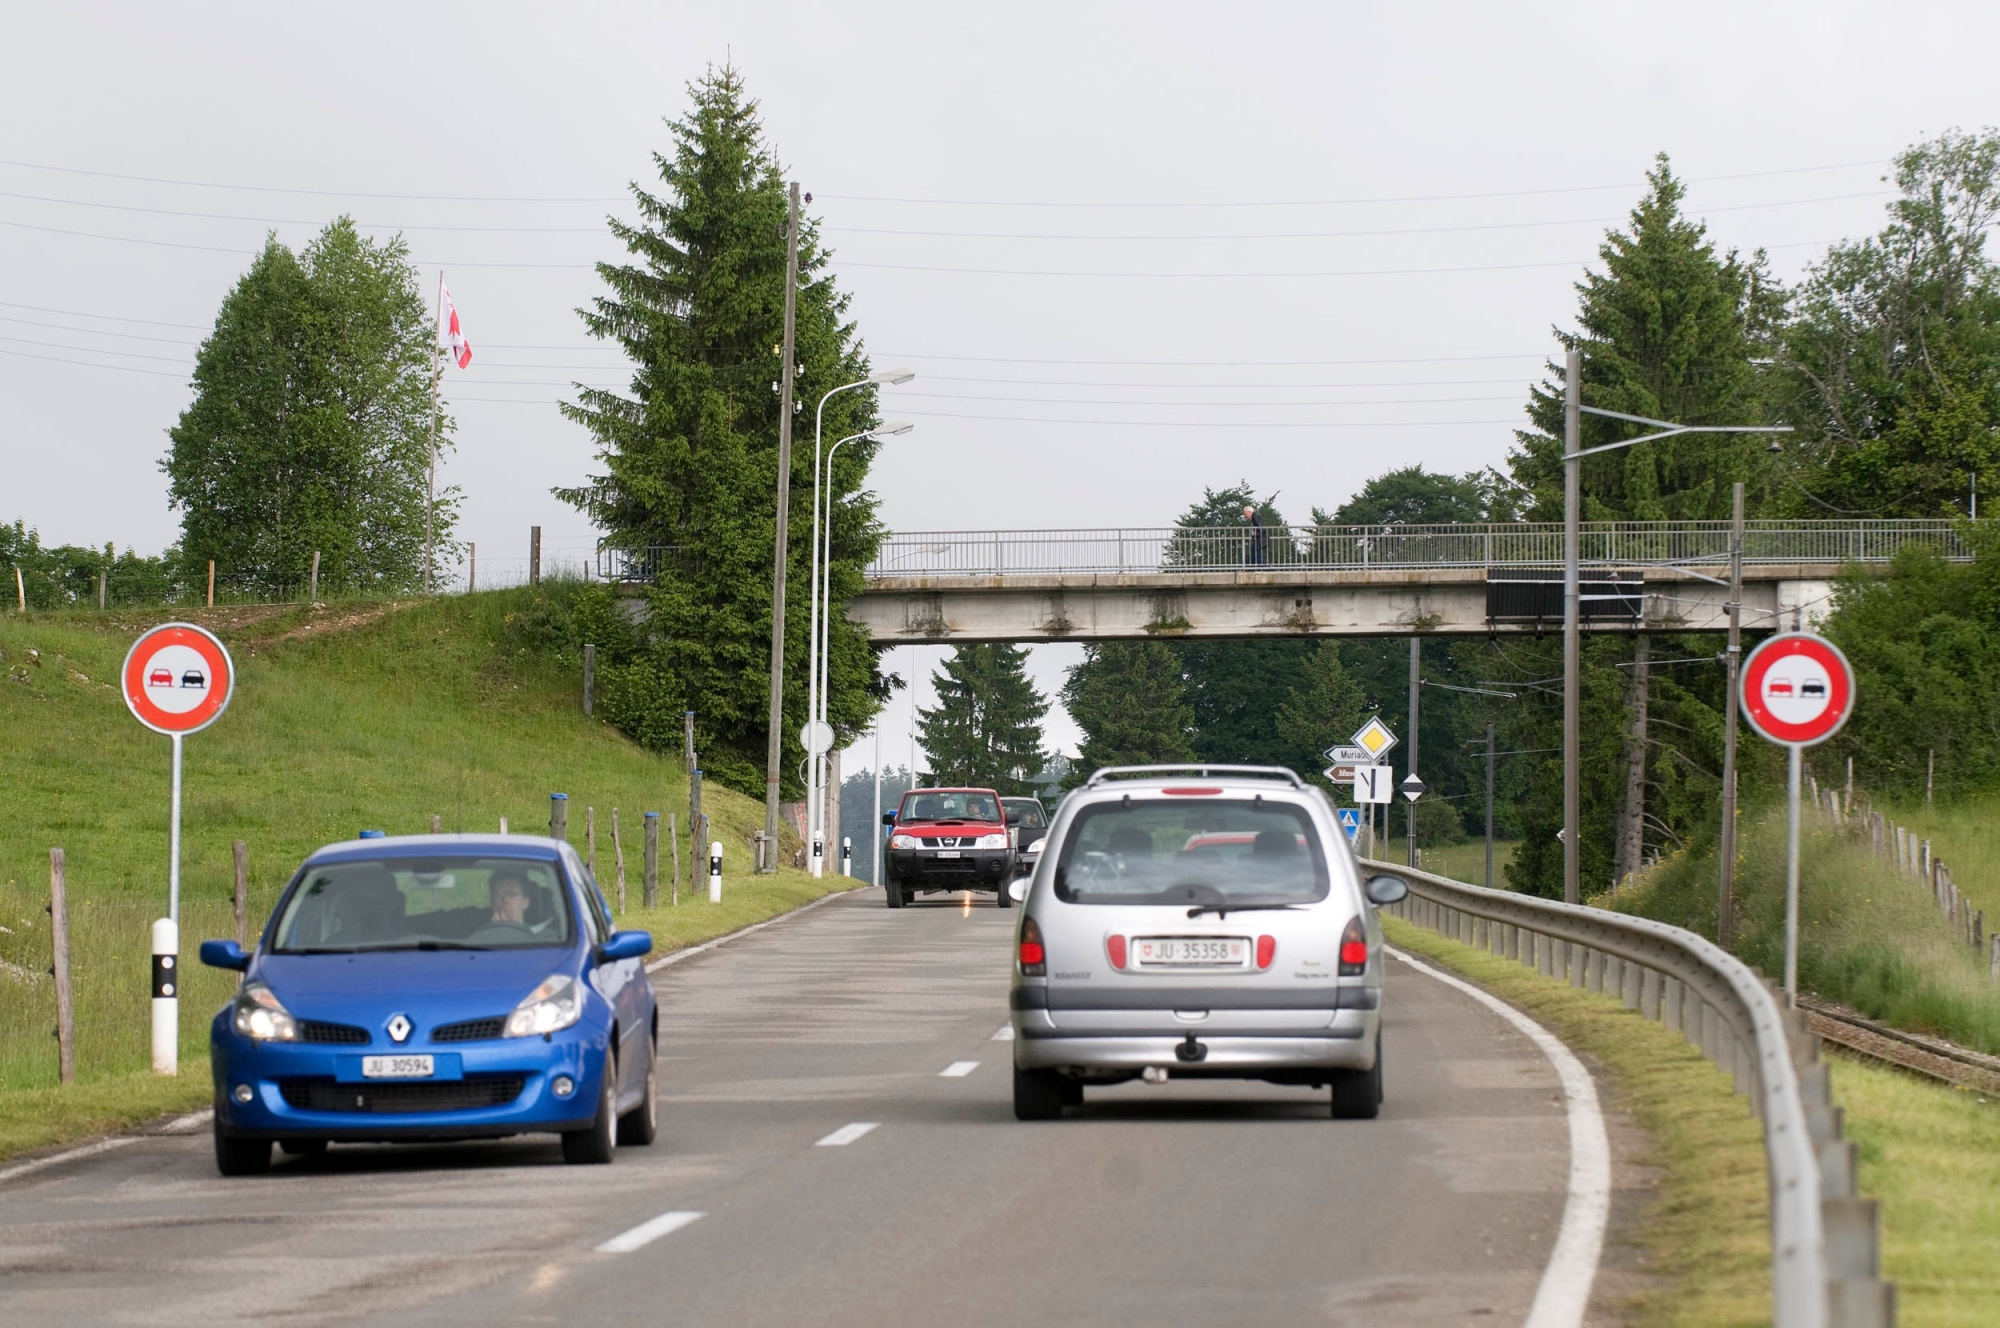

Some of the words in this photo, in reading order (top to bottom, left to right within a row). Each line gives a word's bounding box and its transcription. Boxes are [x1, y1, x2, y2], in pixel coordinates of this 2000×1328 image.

[1341, 750, 1367, 759] Muriau
[1155, 943, 1174, 959] JU
[1182, 943, 1229, 959] 35358
[368, 1060, 383, 1072] JU
[391, 1059, 429, 1072] 30594
